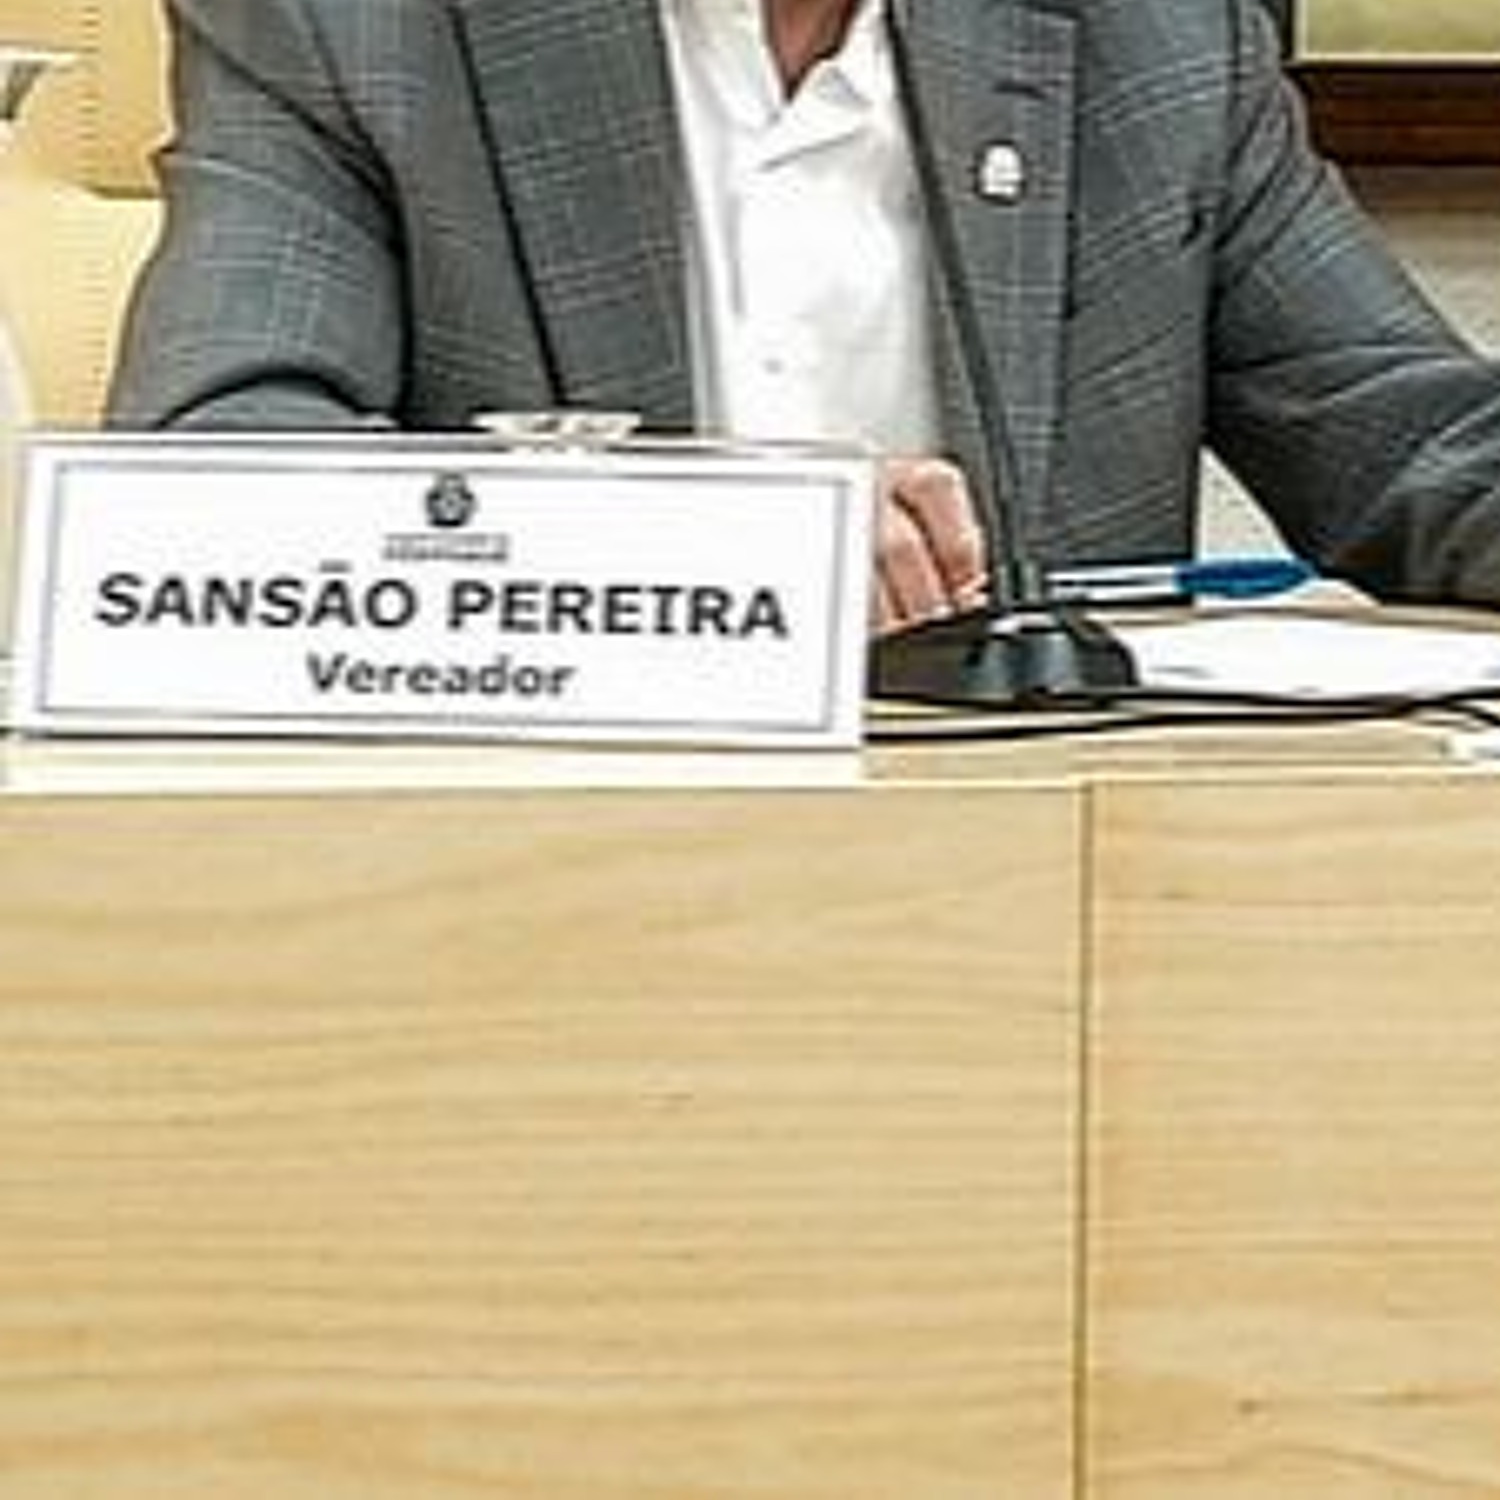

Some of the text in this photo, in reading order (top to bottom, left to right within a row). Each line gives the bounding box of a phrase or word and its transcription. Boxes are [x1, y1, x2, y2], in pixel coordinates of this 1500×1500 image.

[95, 561, 788, 638] SANSÃO PEREIRA
[306, 652, 576, 697] Vereador
